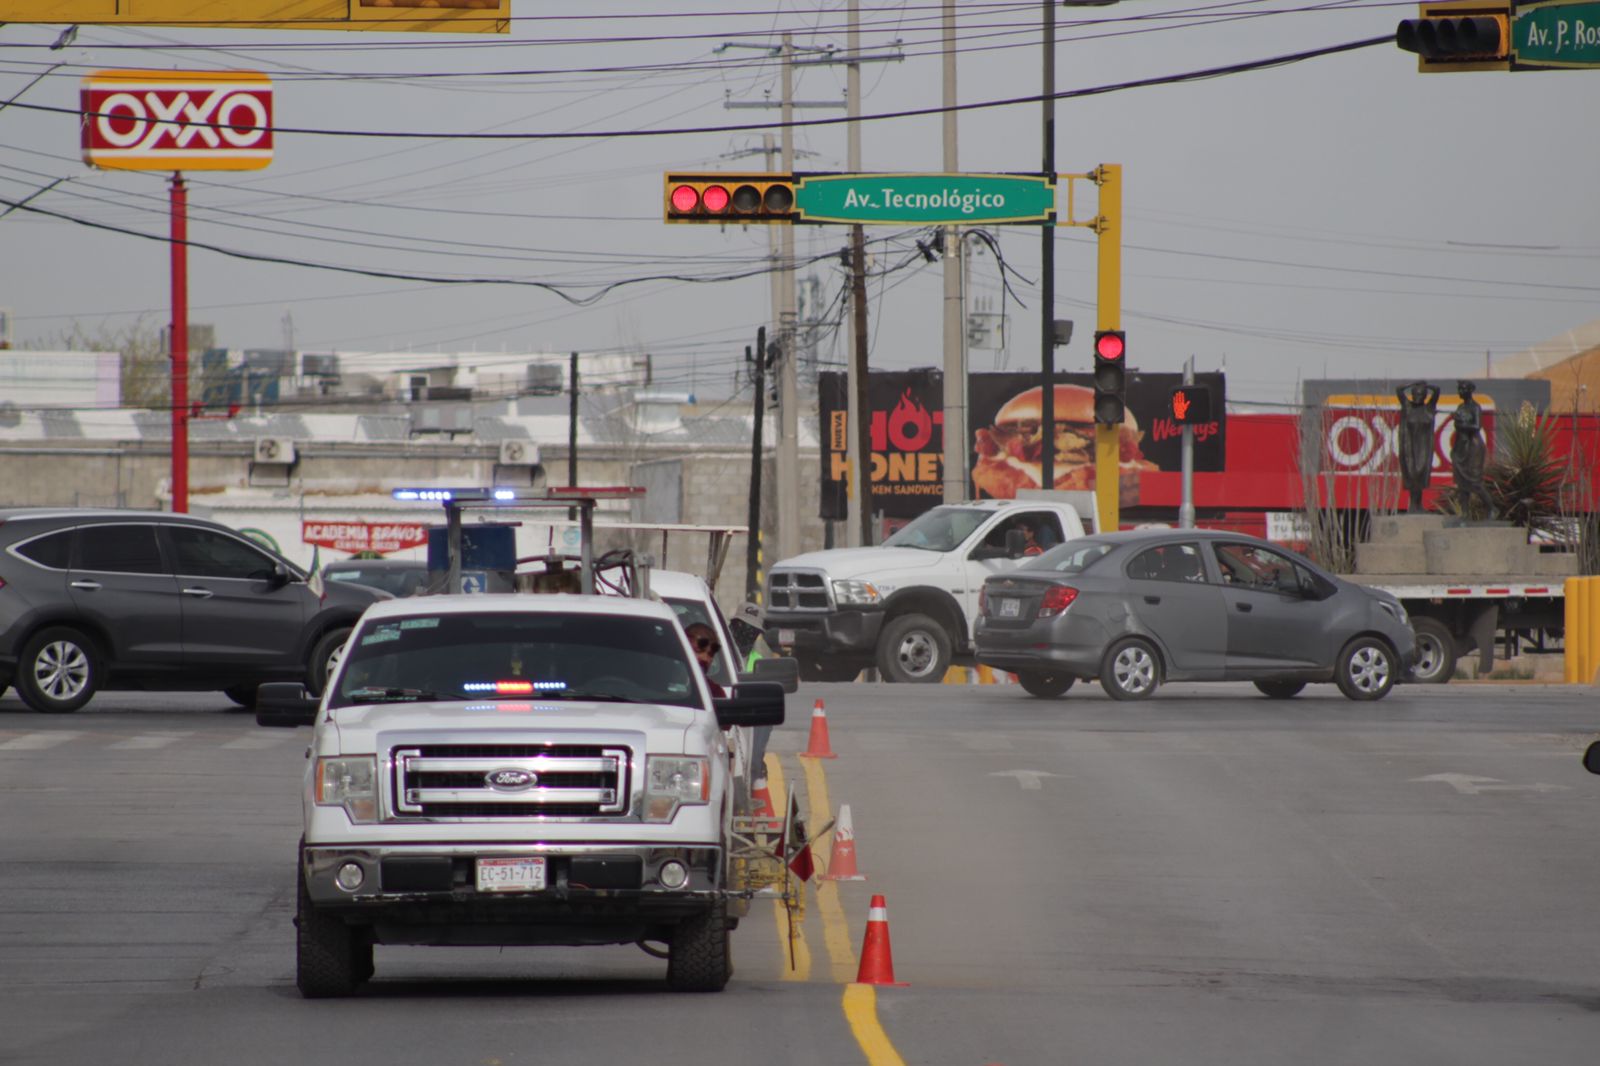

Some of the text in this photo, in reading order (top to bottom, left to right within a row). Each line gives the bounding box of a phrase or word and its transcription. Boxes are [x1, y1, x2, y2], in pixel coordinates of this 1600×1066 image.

[1528, 20, 1553, 47] Av.
[1555, 19, 1570, 54] P.
[98, 91, 268, 149] OXXO
[882, 188, 1005, 213] Tecnológico
[834, 412, 844, 449] NUEVA
[831, 452, 944, 482] HONE
[894, 484, 944, 495] SANDWIC
[304, 525, 426, 542] ACADEMIA BRAVOS
[480, 866, 542, 881] EC-51-712
